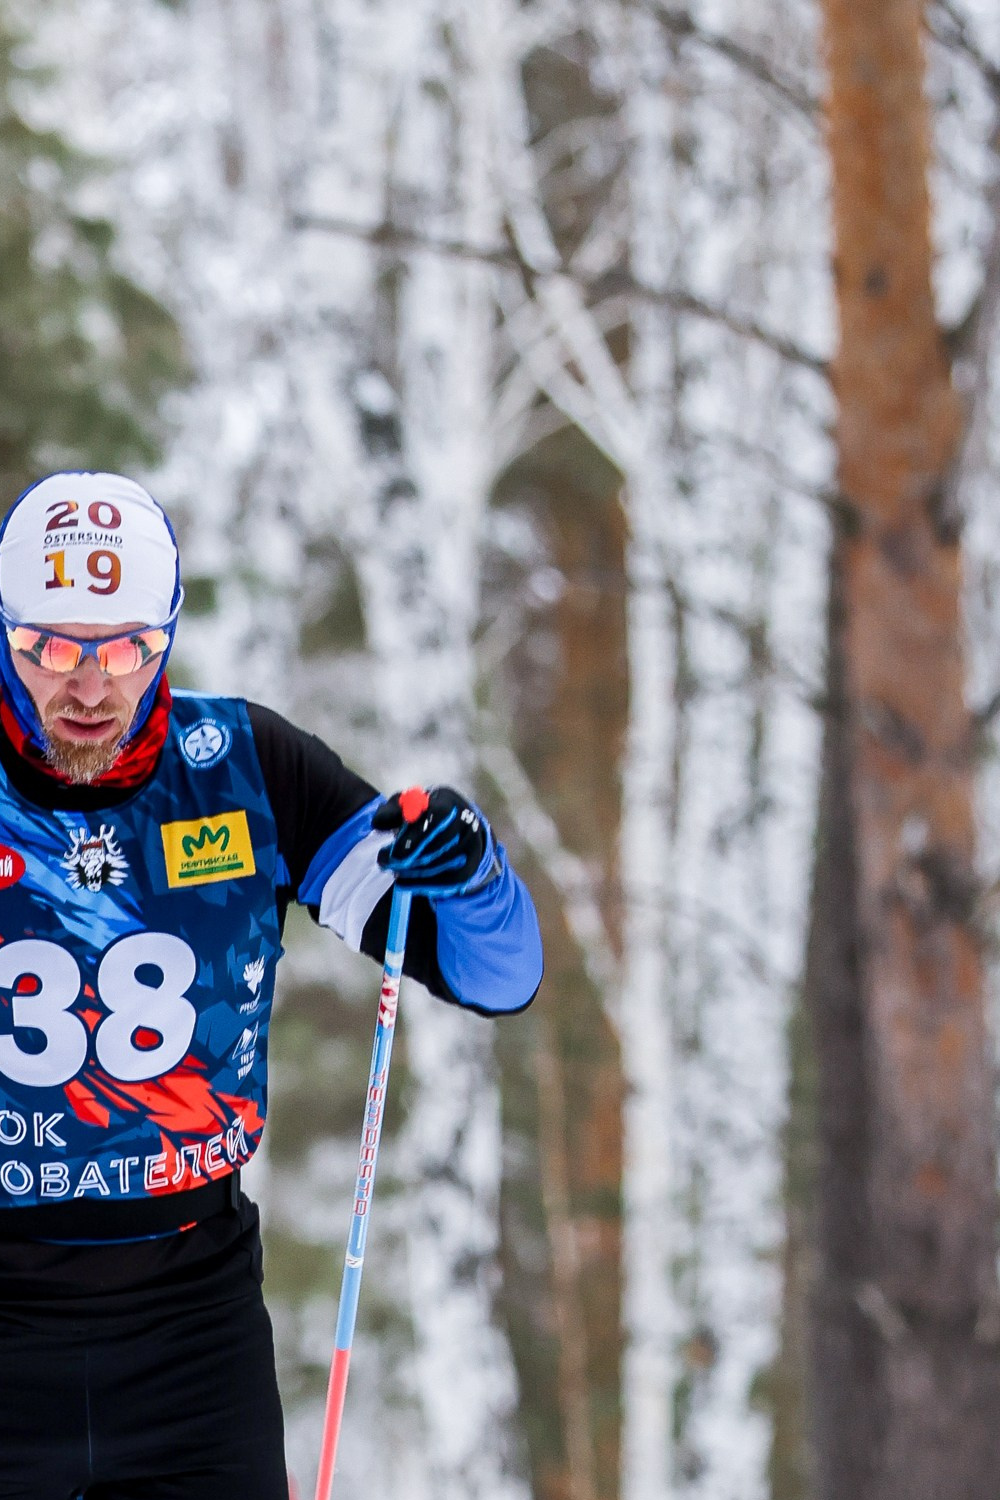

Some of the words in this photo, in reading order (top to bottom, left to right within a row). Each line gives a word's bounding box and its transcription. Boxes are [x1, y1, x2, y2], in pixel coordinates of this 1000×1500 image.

[45, 501, 122, 532] 20
[44, 532, 123, 545] ÖSTERSUND
[45, 550, 122, 595] 19
